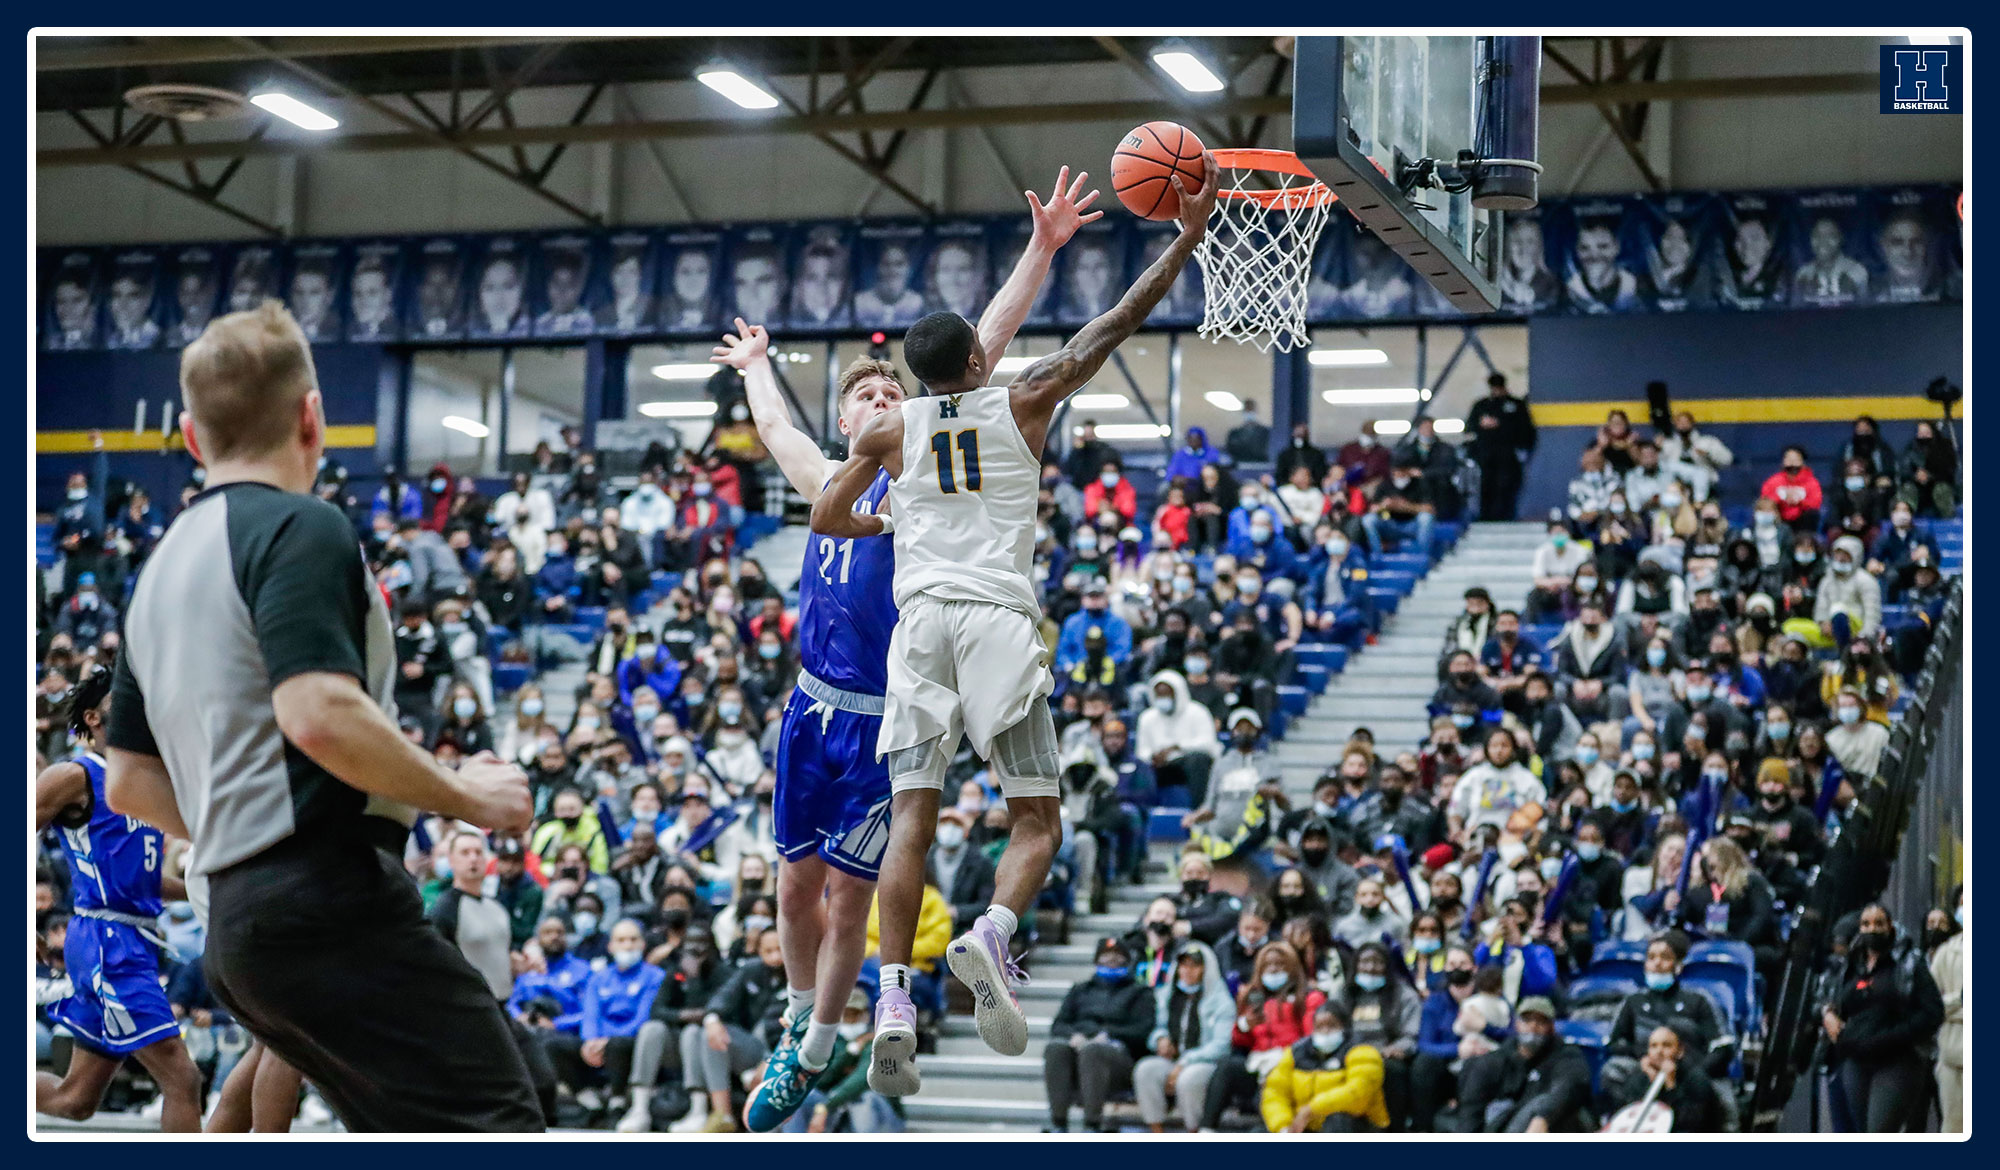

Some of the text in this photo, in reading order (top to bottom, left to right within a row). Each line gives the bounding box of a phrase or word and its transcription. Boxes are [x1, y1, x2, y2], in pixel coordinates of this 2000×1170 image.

[939, 400, 959, 419] H
[930, 427, 983, 495] 11
[819, 537, 855, 585] 21
[143, 834, 157, 872] 5
